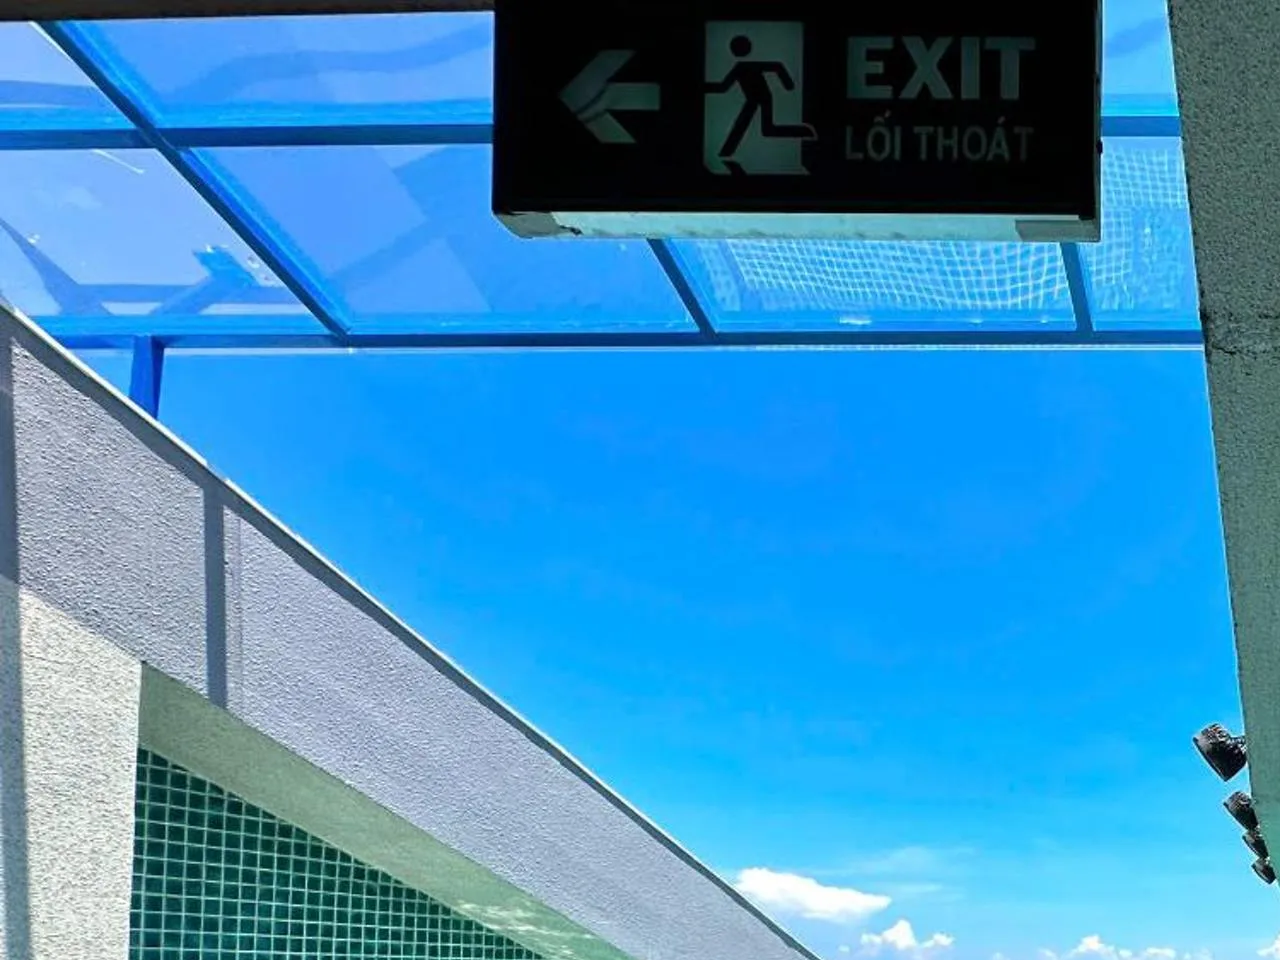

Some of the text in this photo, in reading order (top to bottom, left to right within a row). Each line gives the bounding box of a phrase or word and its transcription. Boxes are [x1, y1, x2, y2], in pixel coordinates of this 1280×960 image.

[847, 36, 1036, 99] EXIT
[846, 109, 1035, 161] LỐI THOÁT
